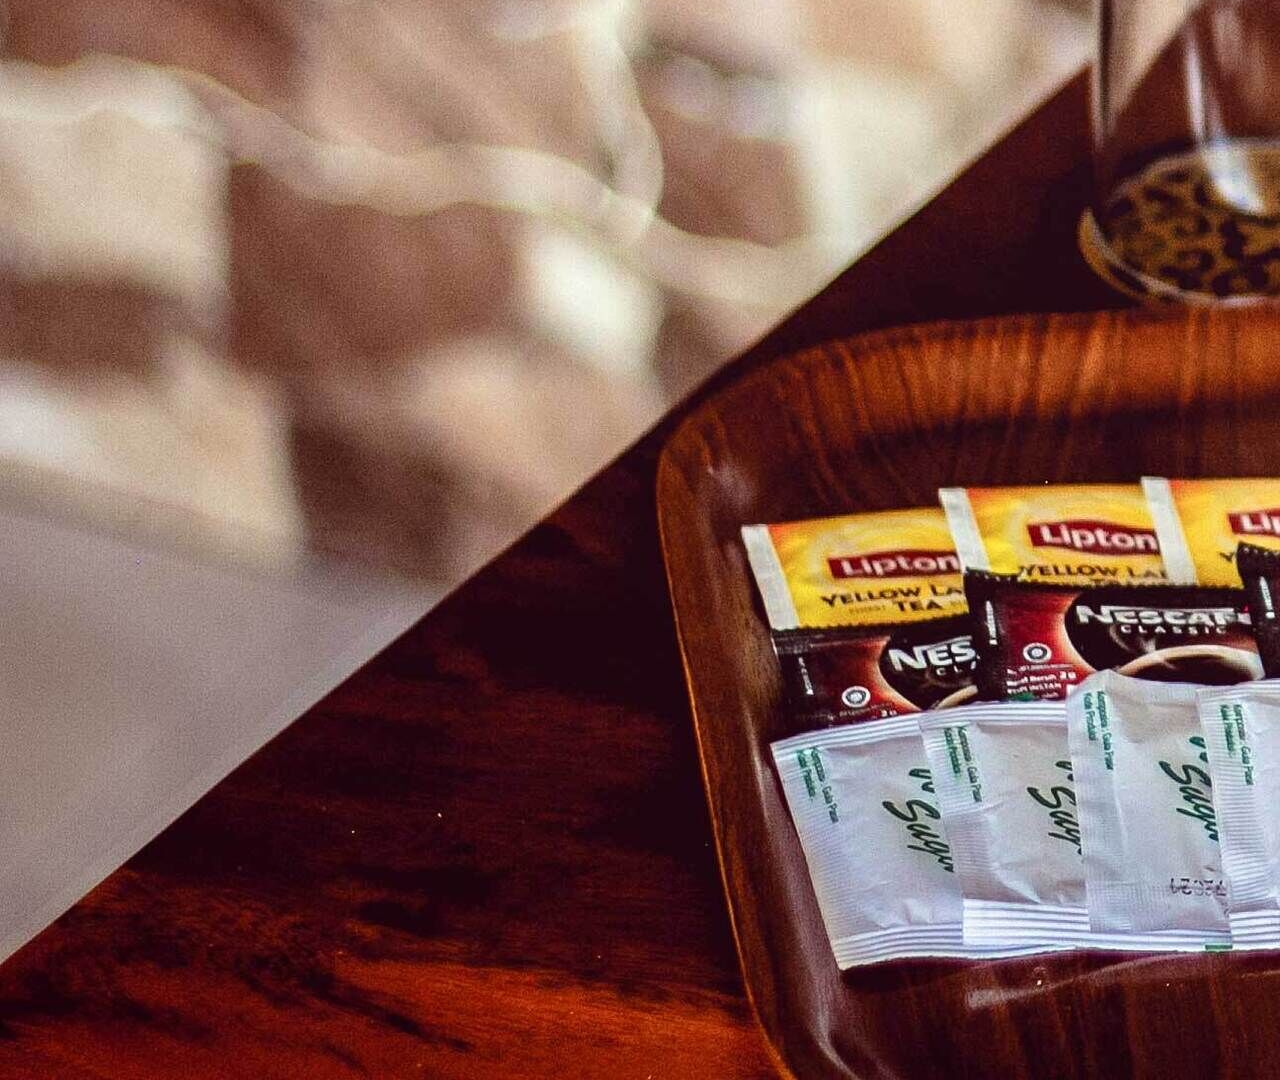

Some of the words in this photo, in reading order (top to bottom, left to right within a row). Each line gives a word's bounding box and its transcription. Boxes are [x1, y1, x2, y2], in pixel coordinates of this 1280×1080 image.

[1039, 523, 1158, 549] Lipton
[840, 554, 961, 576] Lipton
[1020, 564, 1118, 577] YELLOW
[821, 586, 921, 607] YELLOW
[896, 600, 943, 612] TEA
[1120, 624, 1228, 636] CLASSIC
[1102, 732, 1112, 751] Gula
